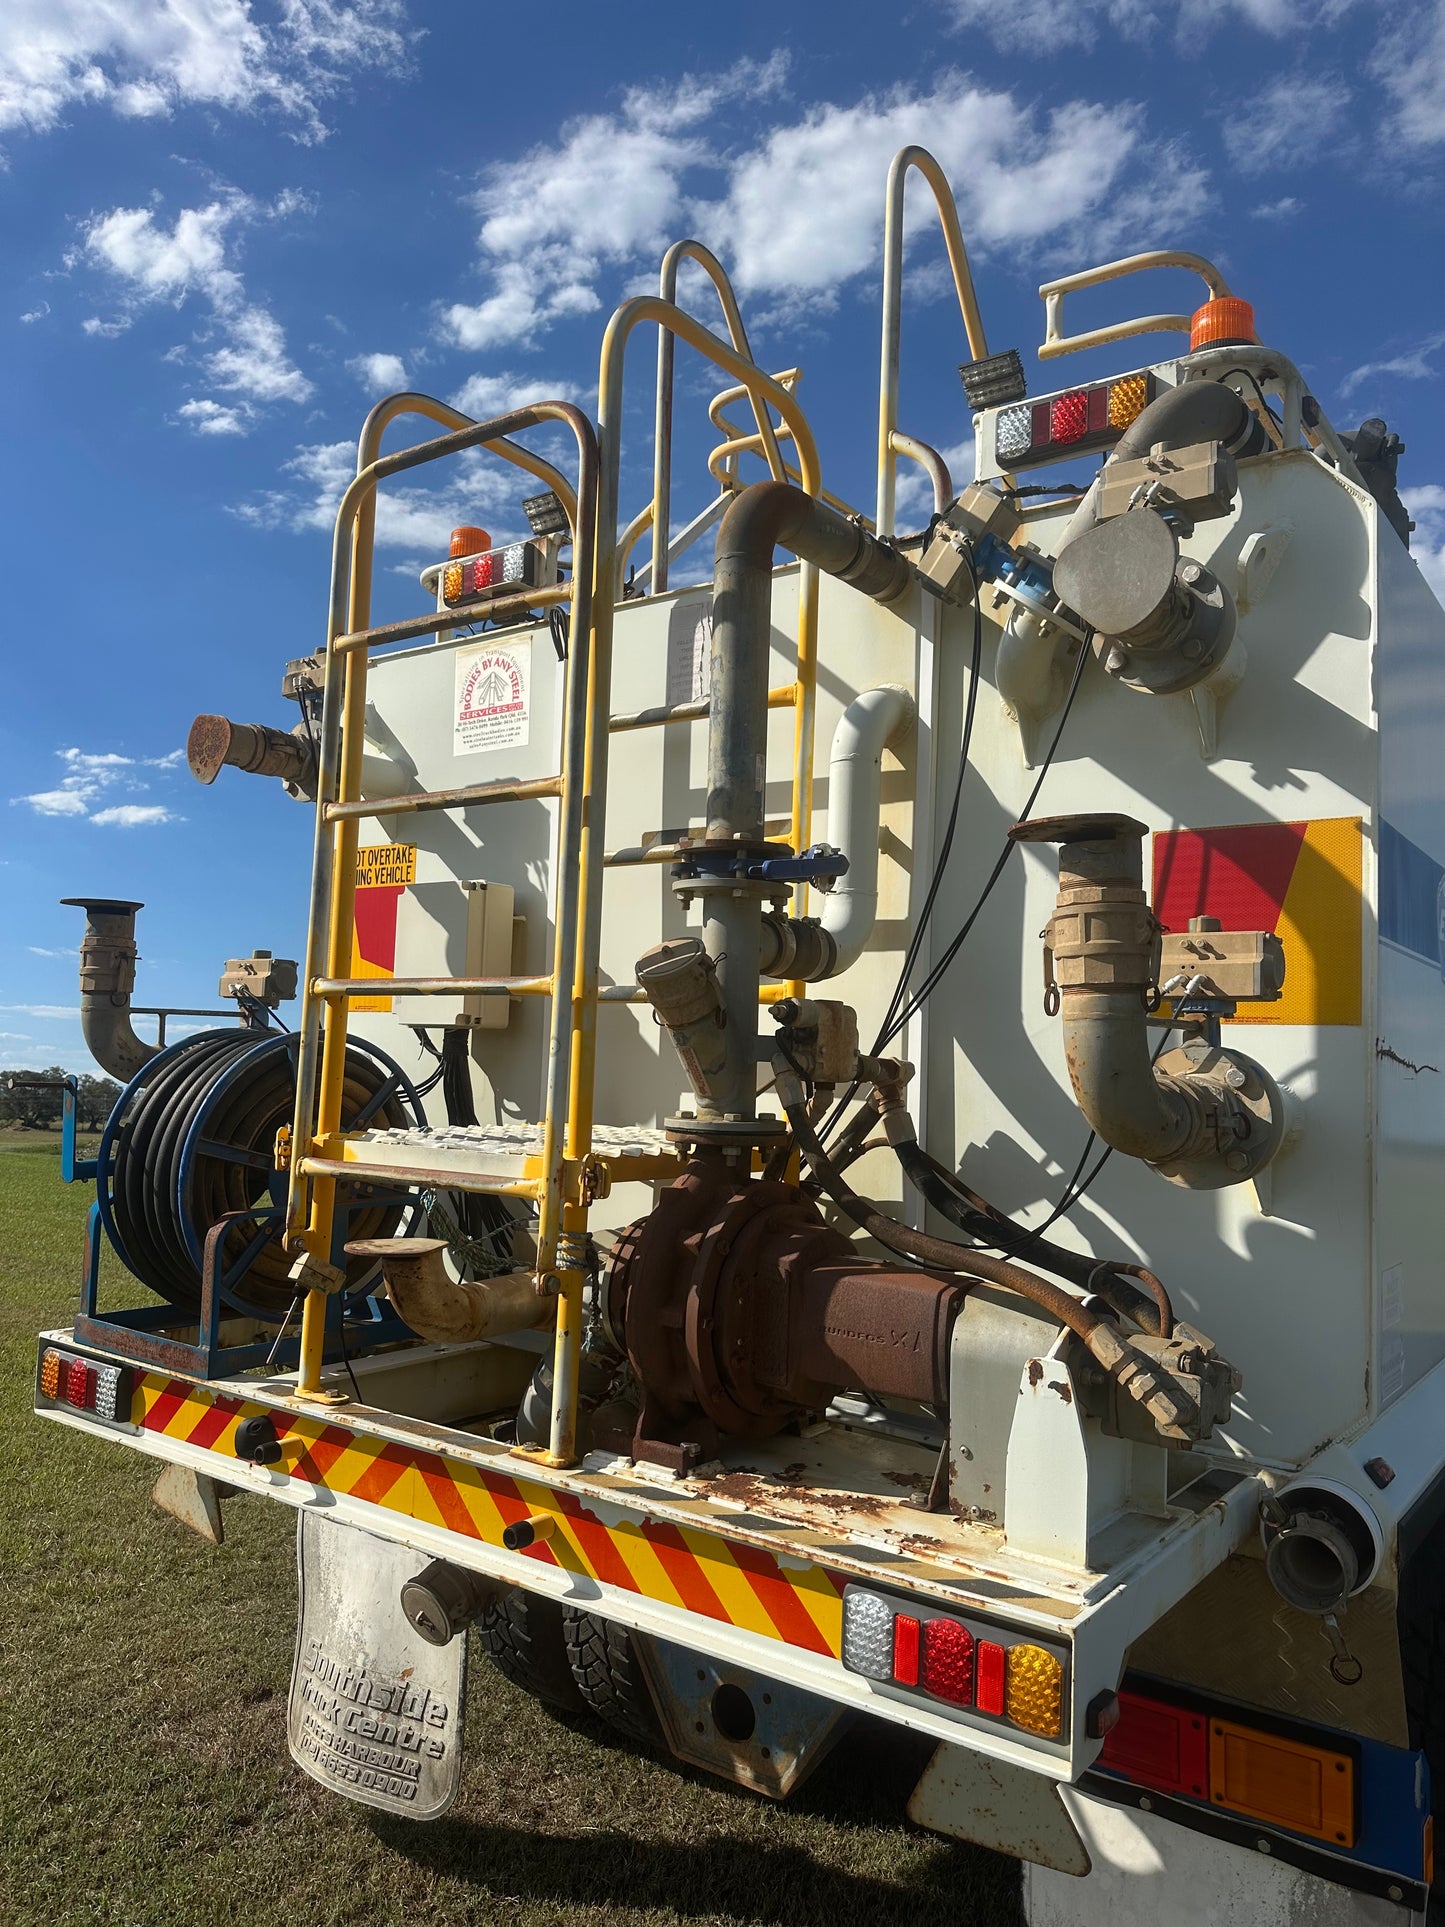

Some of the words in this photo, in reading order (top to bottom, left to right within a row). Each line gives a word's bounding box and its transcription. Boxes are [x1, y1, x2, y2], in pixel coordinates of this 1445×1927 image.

[464, 667, 482, 711] BODIES
[482, 657, 493, 671] BY
[494, 657, 513, 673] ANY
[508, 670, 520, 702] STEEL
[485, 650, 511, 659] Transport
[510, 655, 525, 692] Equipment
[460, 705, 509, 720] SERVICES
[356, 850, 366, 868] OT
[367, 846, 414, 867] OVERTAKE
[374, 865, 412, 885] VEHICLE
[824, 1326, 886, 1345] UNDFOS
[303, 1637, 448, 1729] Southside
[301, 1673, 342, 1726] Truck
[343, 1706, 446, 1760] Centre
[318, 1750, 363, 1784] 6653
[360, 1770, 419, 1801] 0900
[332, 1736, 422, 1777] HARBOUR
